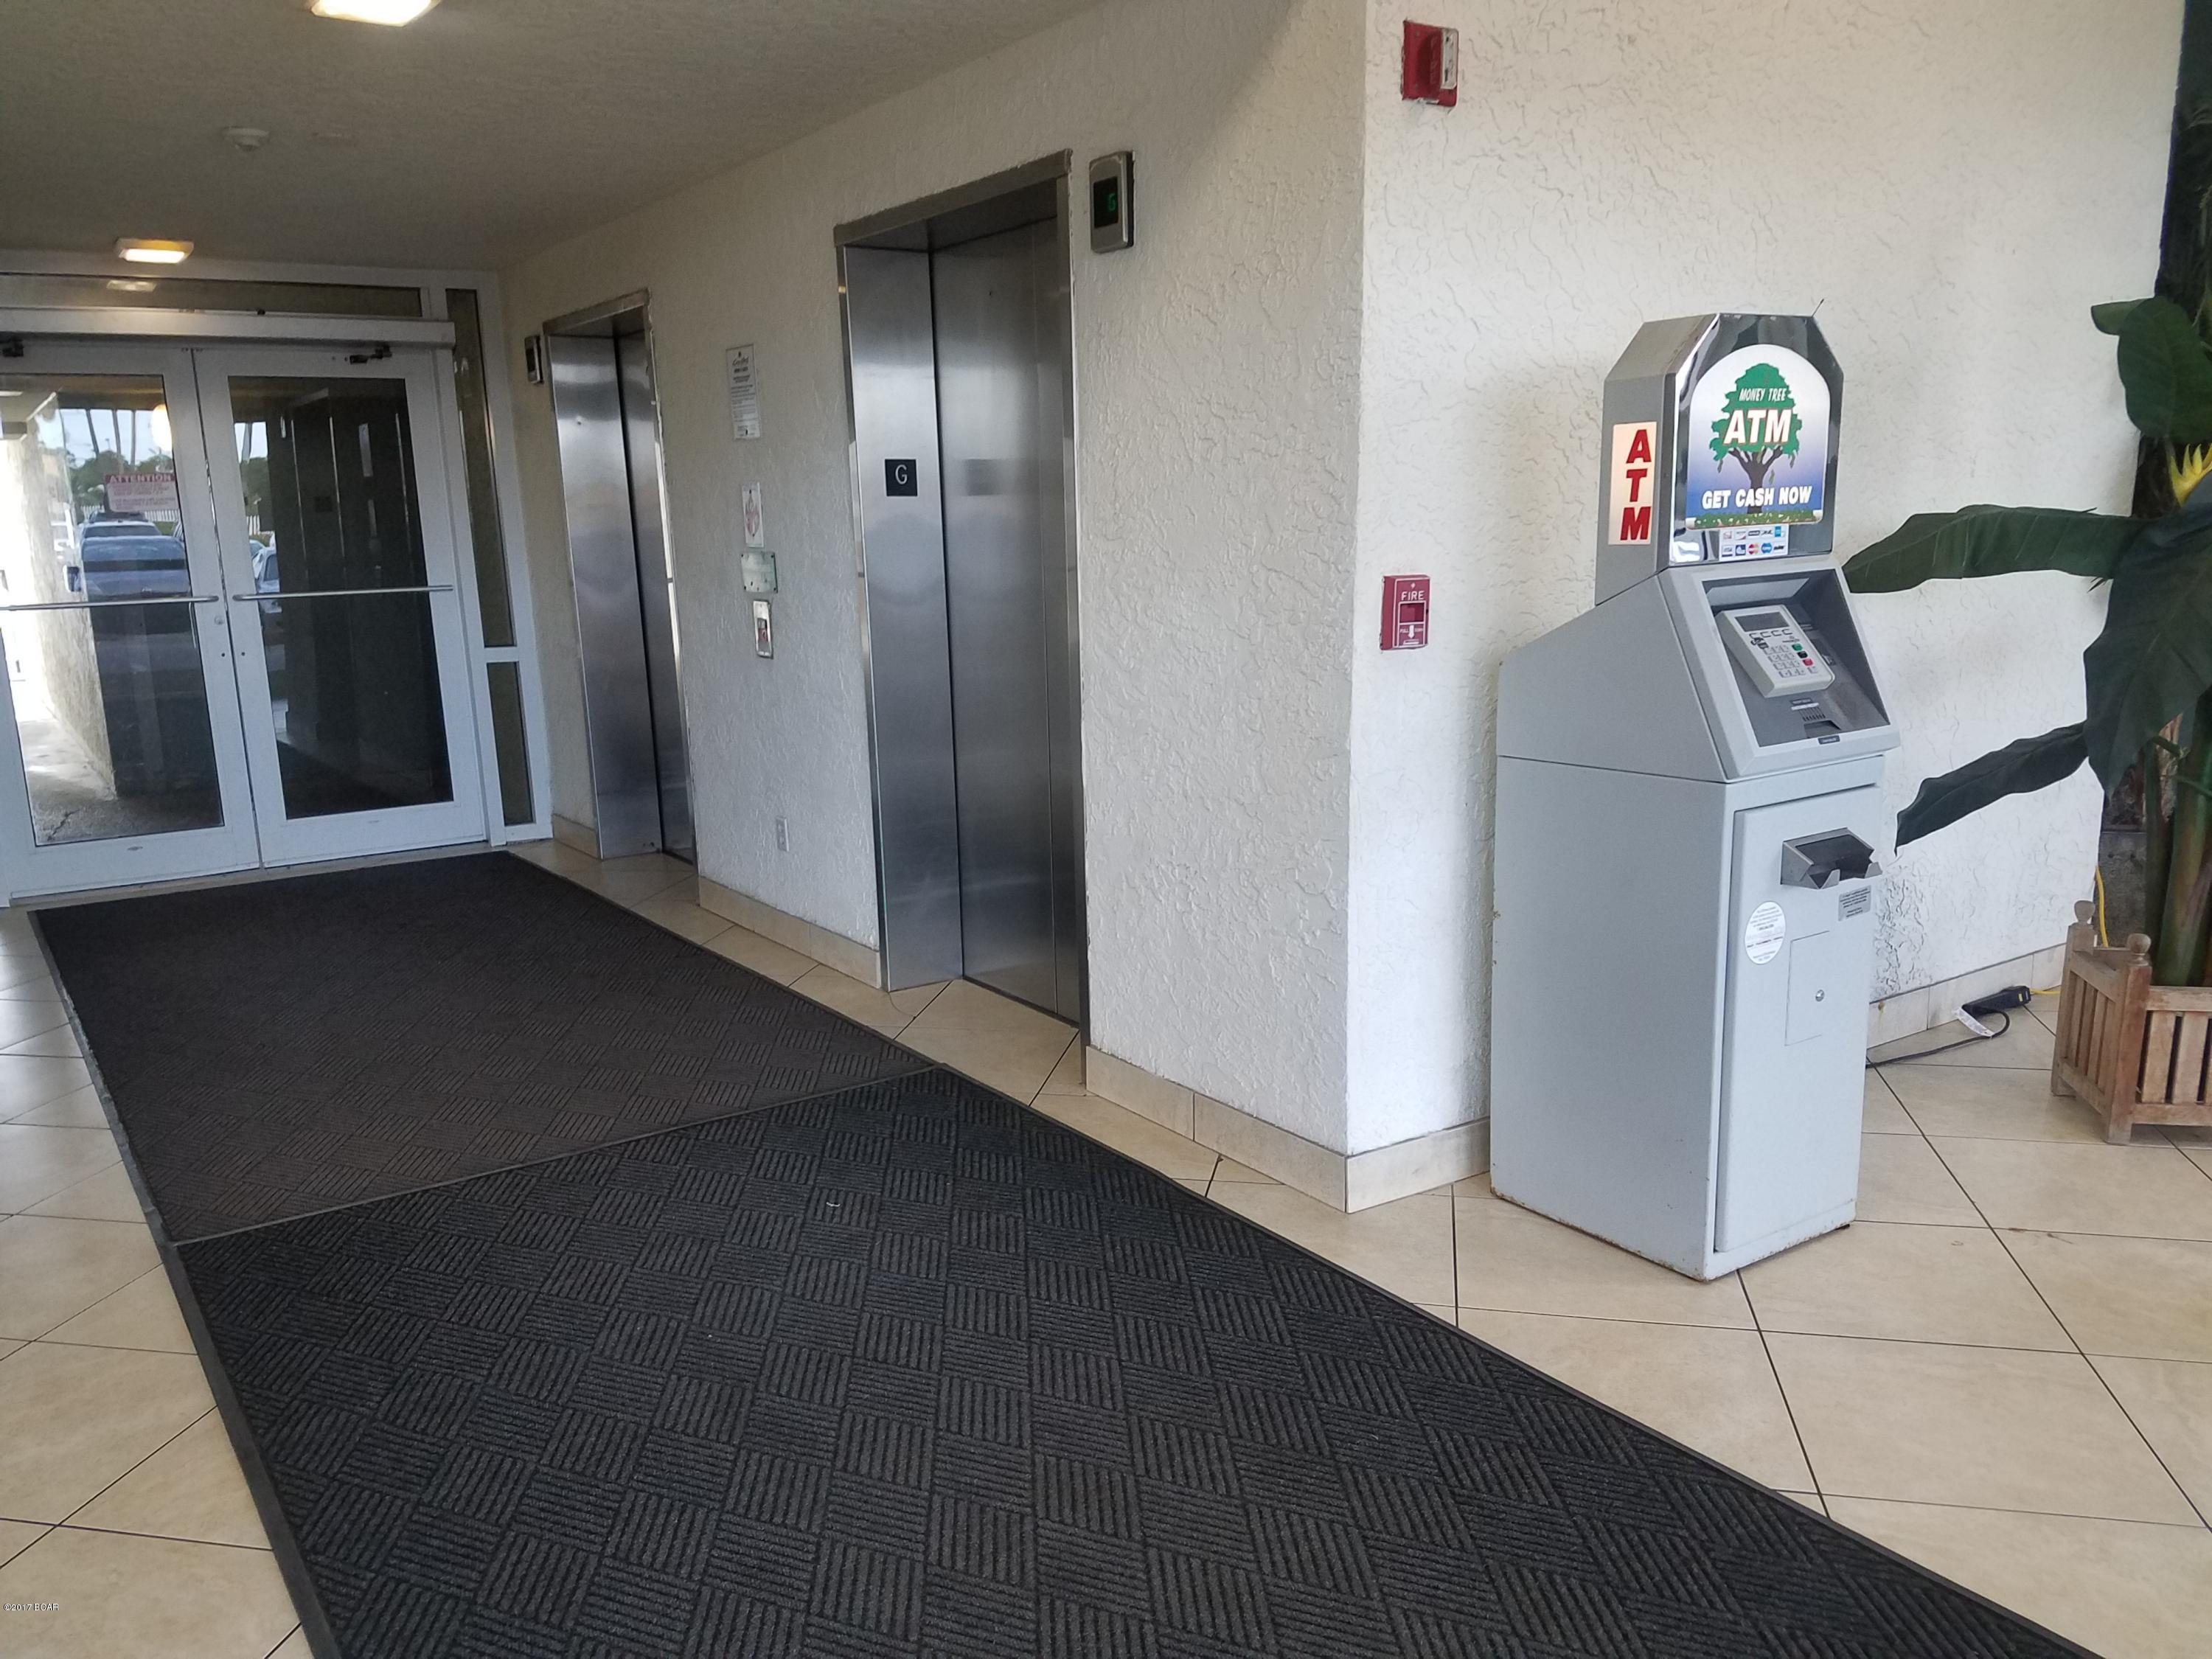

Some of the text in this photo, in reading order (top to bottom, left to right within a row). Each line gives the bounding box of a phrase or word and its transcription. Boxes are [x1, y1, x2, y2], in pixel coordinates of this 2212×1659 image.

[1739, 388, 1787, 402] MONEY TREE
[1723, 408, 1791, 444] ATM
[109, 474, 170, 484] ATTENTION
[895, 465, 907, 484] G
[1621, 429, 1652, 540] ATM
[1702, 486, 1812, 509] GET CASH NOW
[1401, 590, 1425, 600] FIRE
